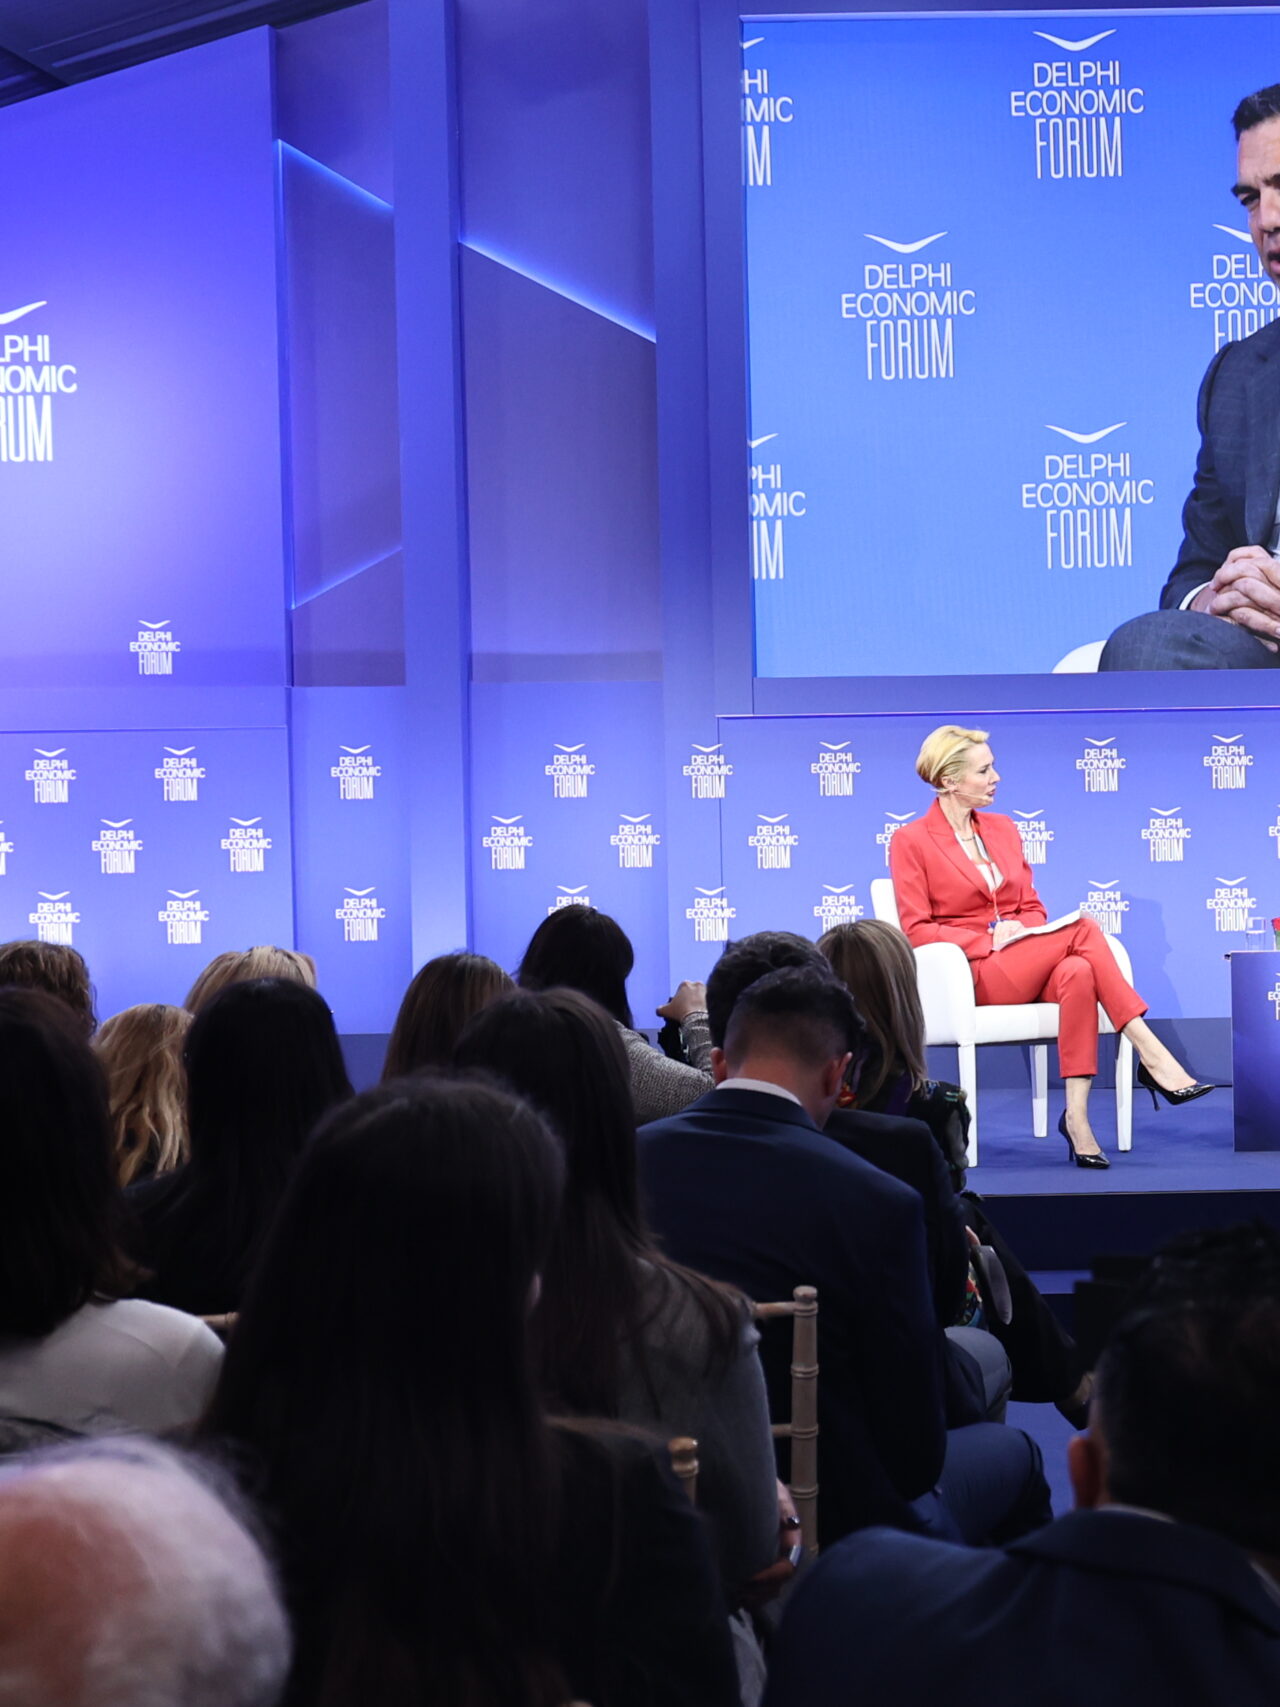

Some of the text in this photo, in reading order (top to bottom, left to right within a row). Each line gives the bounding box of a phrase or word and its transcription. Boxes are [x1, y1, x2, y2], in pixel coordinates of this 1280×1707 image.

[1033, 60, 1120, 87] DELPHI
[1010, 87, 1145, 116] ECONOMIC
[1035, 116, 1123, 179] FORUM
[864, 262, 952, 290] DELPHI
[841, 289, 976, 318] ECONOMIC
[866, 318, 954, 381] FORUM
[1044, 452, 1130, 480] DELPHI
[1022, 479, 1154, 508] ECONOMIC
[1046, 507, 1132, 569] FORUM
[138, 631, 172, 642] DELPHI
[130, 640, 180, 652] ECONOMIC
[139, 650, 172, 675] FORUM
[1084, 748, 1118, 759] DELPHI
[1212, 746, 1245, 756] DELPHI
[163, 758, 197, 768] DELPHI
[339, 756, 373, 767] DELPHI
[554, 754, 587, 765] DELPHI
[691, 755, 725, 765] DELPHI
[819, 753, 852, 763] DELPHI
[1076, 758, 1126, 770] ECONOMIC
[1203, 755, 1253, 767] ECONOMIC
[34, 759, 68, 770] DELPHI
[545, 764, 595, 776] ECONOMIC
[683, 764, 733, 776] ECONOMIC
[811, 762, 861, 774] ECONOMIC
[25, 769, 76, 781] ECONOMIC
[155, 767, 205, 779] ECONOMIC
[331, 766, 381, 777] ECONOMIC
[1212, 765, 1245, 790] FORUM
[554, 774, 587, 798] FORUM
[692, 774, 725, 799] FORUM
[820, 772, 853, 797] FORUM
[1085, 768, 1118, 793] FORUM
[34, 779, 68, 804] FORUM
[164, 777, 197, 802] FORUM
[340, 776, 373, 800] FORUM
[1150, 818, 1183, 828] DELPHI
[100, 830, 134, 841] DELPHI
[229, 828, 263, 839] DELPHI
[491, 826, 524, 837] DELPHI
[619, 825, 652, 835] DELPHI
[757, 825, 790, 836] DELPHI
[1141, 828, 1191, 839] ECONOMIC
[92, 839, 143, 851] ECONOMIC
[221, 837, 272, 850] ECONOMIC
[483, 835, 533, 847] ECONOMIC
[610, 834, 660, 846] ECONOMIC
[748, 835, 798, 846] ECONOMIC
[619, 844, 652, 868] FORUM
[1150, 838, 1183, 862] FORUM
[101, 850, 135, 874] FORUM
[230, 848, 264, 873] FORUM
[492, 846, 525, 870] FORUM
[757, 845, 790, 869] FORUM
[1088, 890, 1121, 901] DELPHI
[1215, 888, 1248, 898] DELPHI
[167, 900, 201, 911] DELPHI
[344, 898, 377, 908] DELPHI
[695, 898, 728, 908] DELPHI
[822, 895, 855, 906] DELPHI
[1079, 900, 1129, 912] ECONOMIC
[1206, 897, 1256, 909] ECONOMIC
[37, 902, 72, 913] DELPHI
[335, 907, 385, 919] ECONOMIC
[686, 907, 736, 919] ECONOMIC
[813, 905, 864, 917] ECONOMIC
[29, 912, 80, 924] ECONOMIC
[158, 910, 209, 922] ECONOMIC
[1215, 908, 1249, 932] FORUM
[38, 922, 72, 945] FORUM
[168, 920, 201, 945] FORUM
[344, 917, 378, 941] FORUM
[695, 917, 728, 941] FORUM
